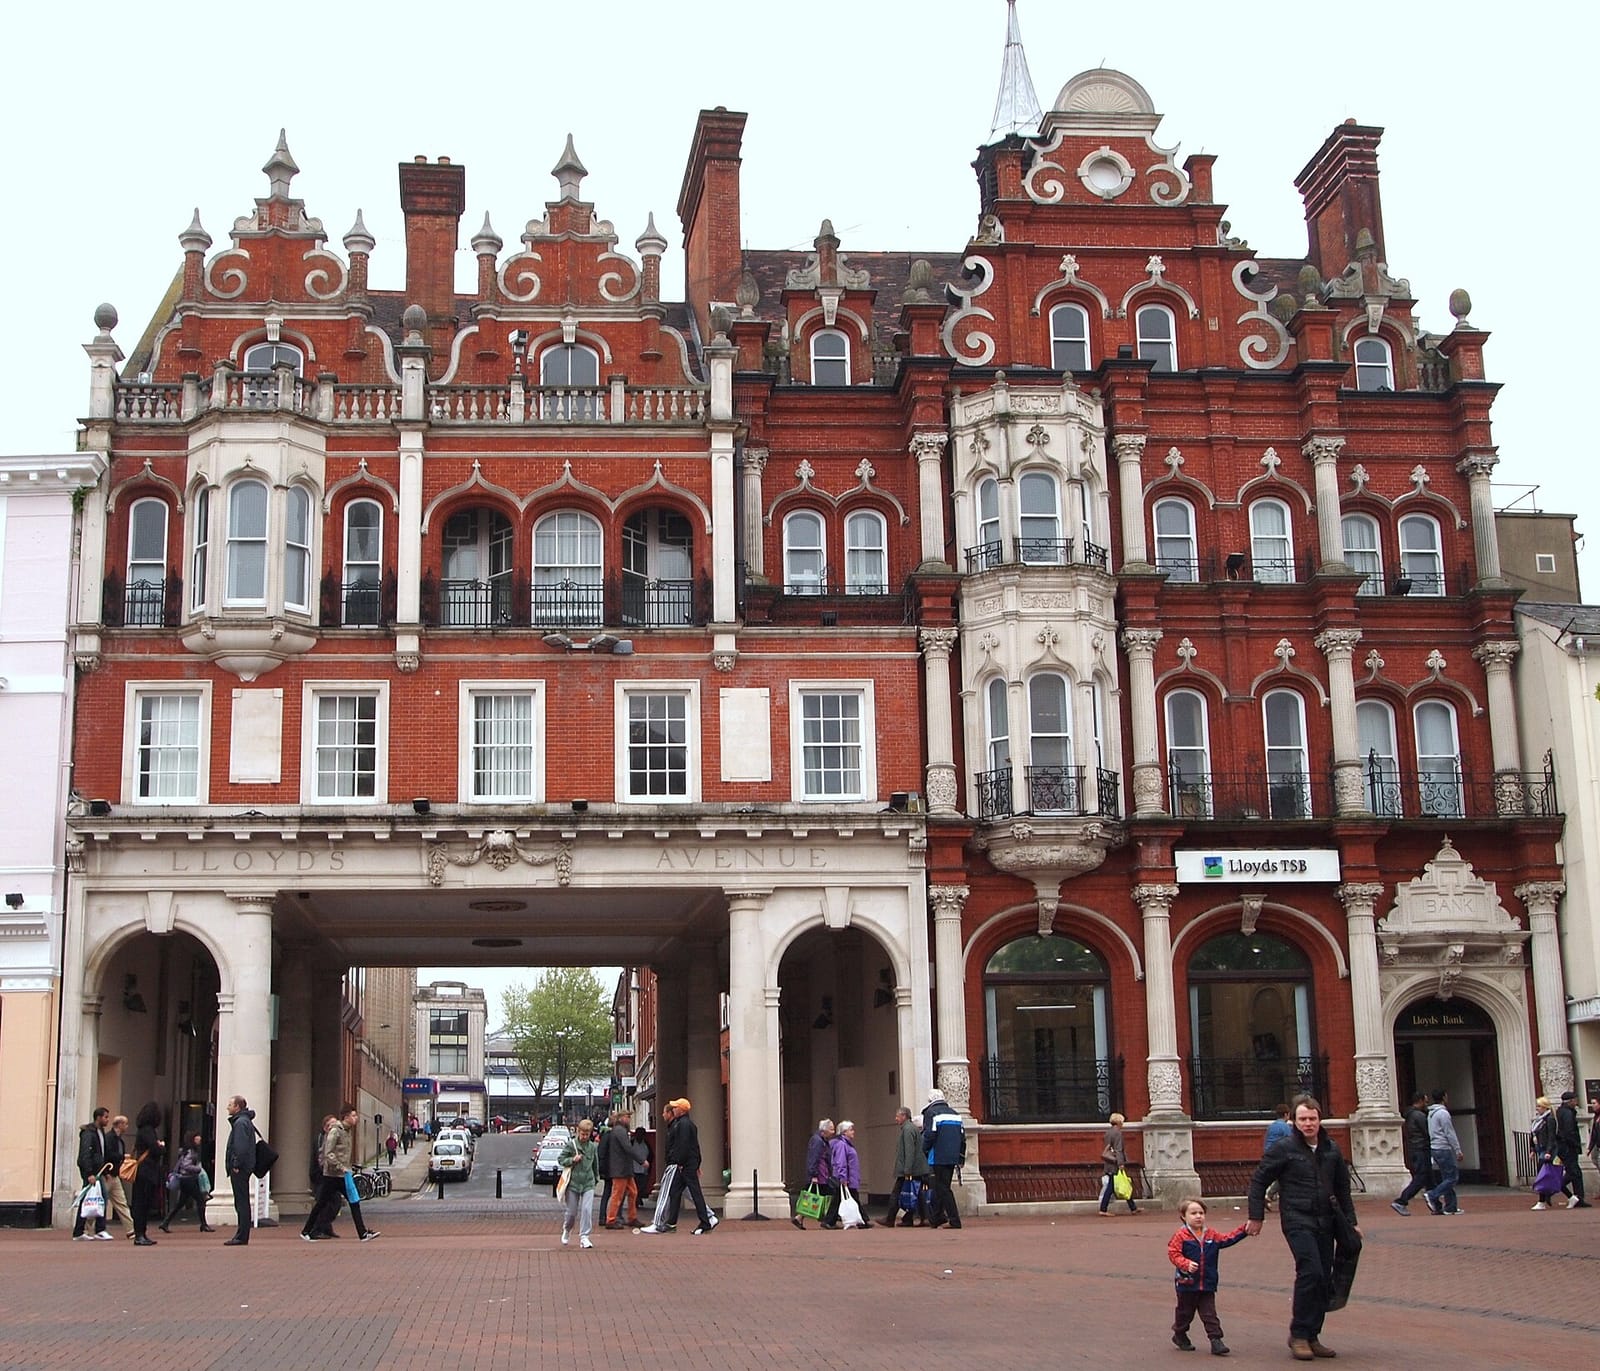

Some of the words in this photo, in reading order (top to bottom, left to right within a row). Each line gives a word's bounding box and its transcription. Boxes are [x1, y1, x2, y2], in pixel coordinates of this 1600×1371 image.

[172, 850, 345, 871] LLOYDS
[656, 847, 827, 868] AVENUE
[1229, 858, 1278, 876] Lloyds
[1280, 859, 1307, 872] TSB
[1425, 899, 1473, 913] BANK
[1412, 1015, 1438, 1027] Lloyds
[1443, 1015, 1464, 1025] Bank
